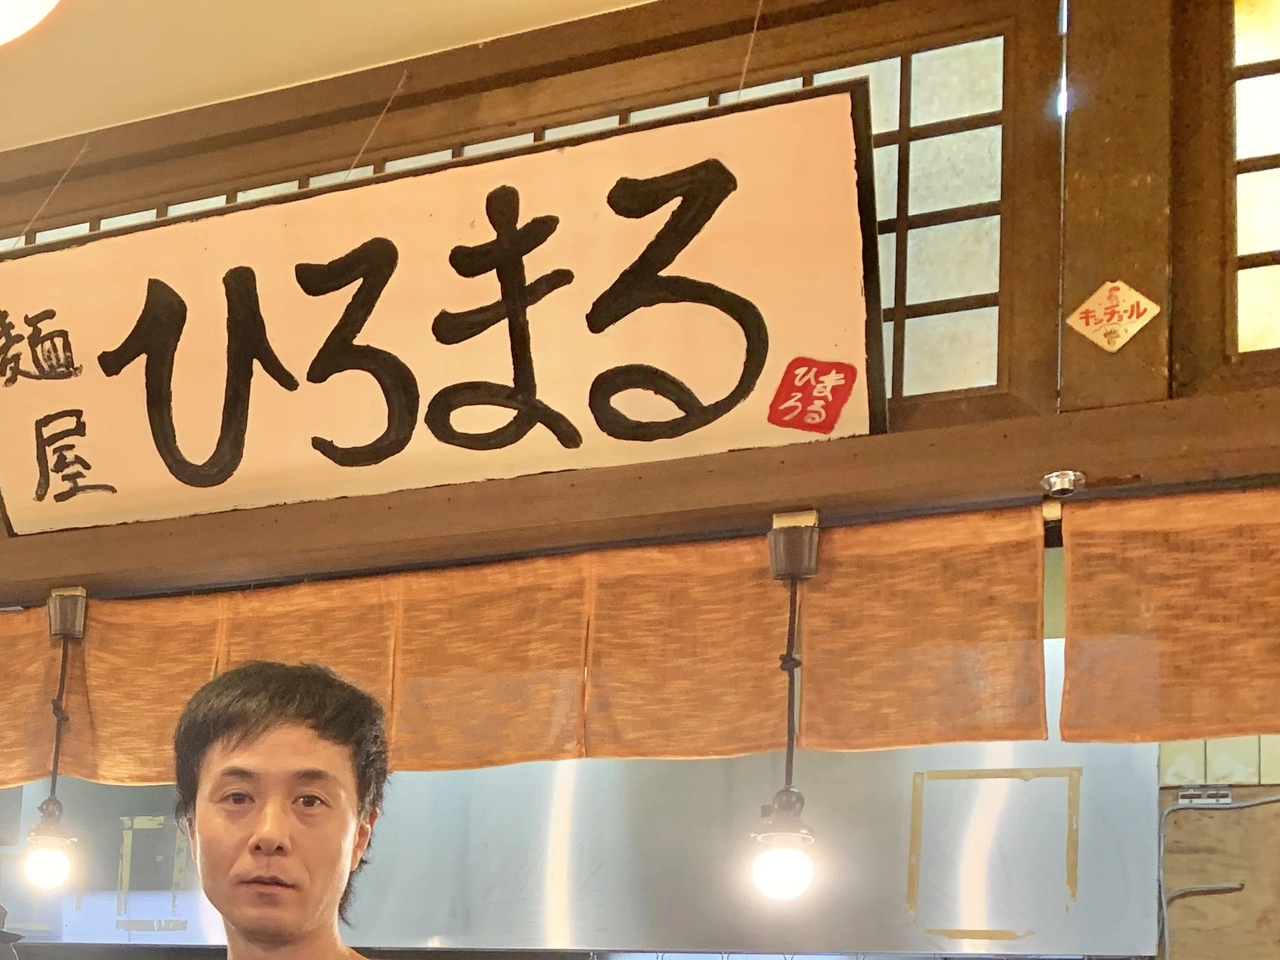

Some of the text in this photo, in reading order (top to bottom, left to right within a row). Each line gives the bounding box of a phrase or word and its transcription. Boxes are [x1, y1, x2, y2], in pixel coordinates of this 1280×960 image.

[98, 157, 769, 488] ひろまる
[1079, 300, 1148, 327] キンチョール
